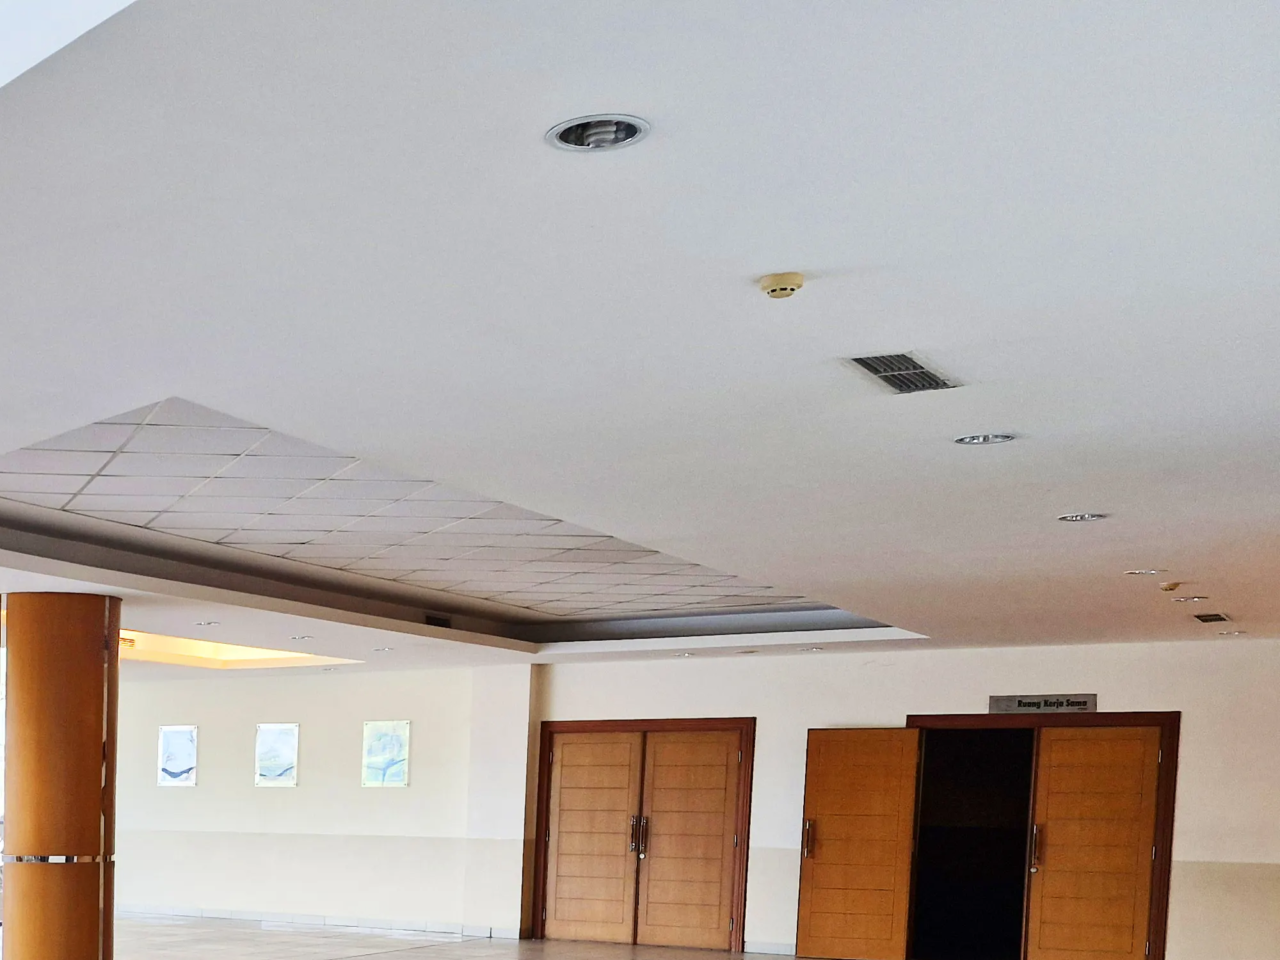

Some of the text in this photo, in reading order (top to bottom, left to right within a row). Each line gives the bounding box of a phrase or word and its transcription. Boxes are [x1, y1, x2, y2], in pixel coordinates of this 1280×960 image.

[1017, 699, 1088, 709] Ruang Kerja Sama
